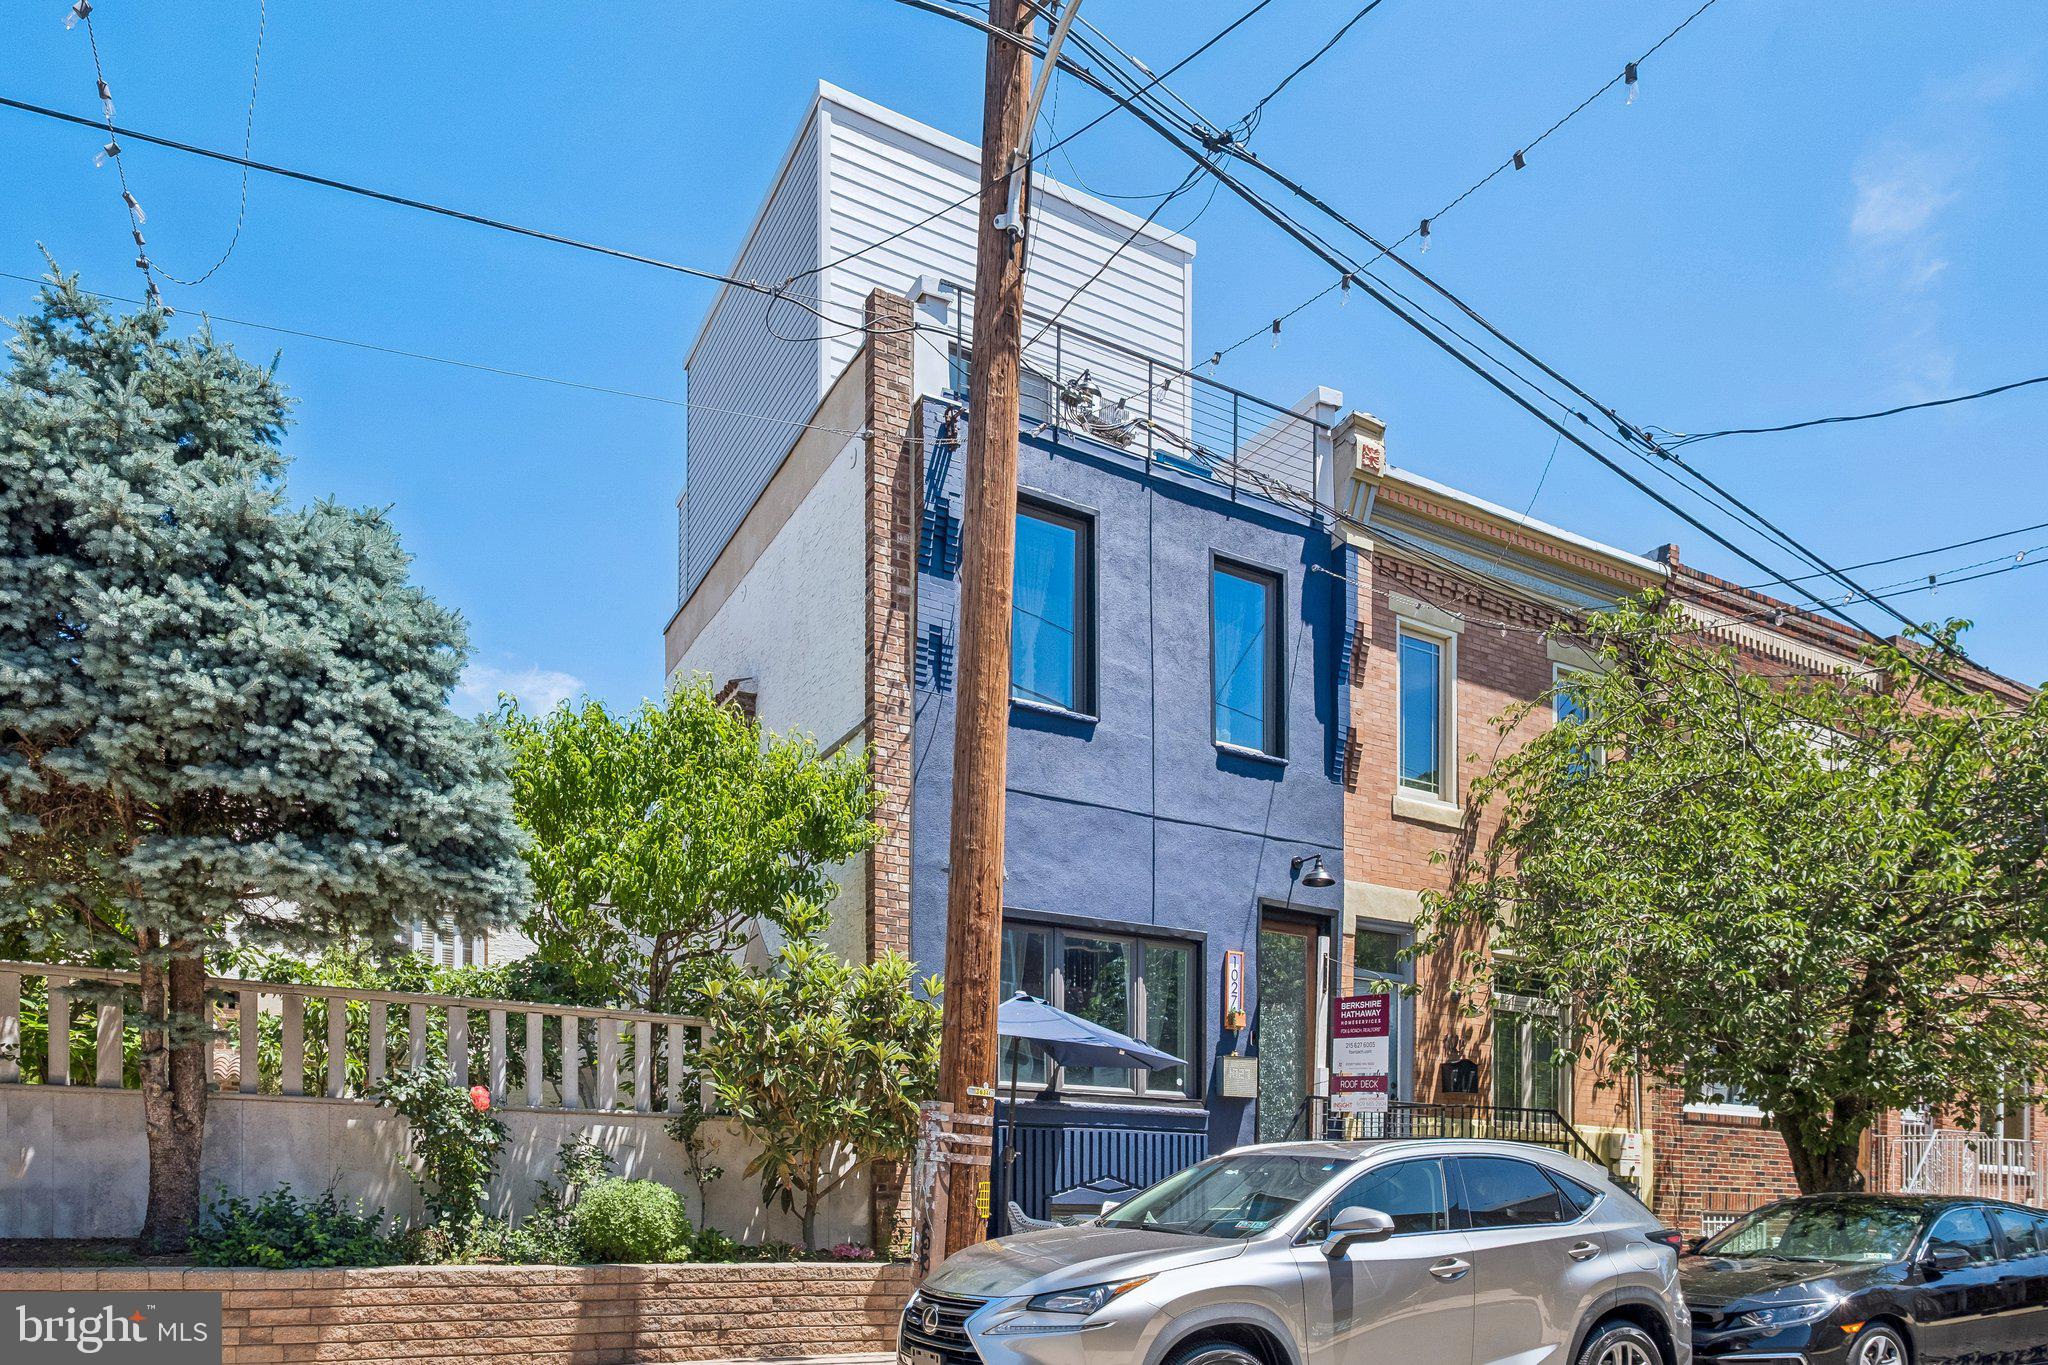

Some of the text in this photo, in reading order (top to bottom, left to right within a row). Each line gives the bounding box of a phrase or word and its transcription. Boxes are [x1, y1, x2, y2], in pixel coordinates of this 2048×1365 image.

[1341, 1000, 1382, 1010] BERKSHIRE
[1341, 1009, 1382, 1018] HATHAWAY
[1341, 1080, 1378, 1088] ROOF DECK
